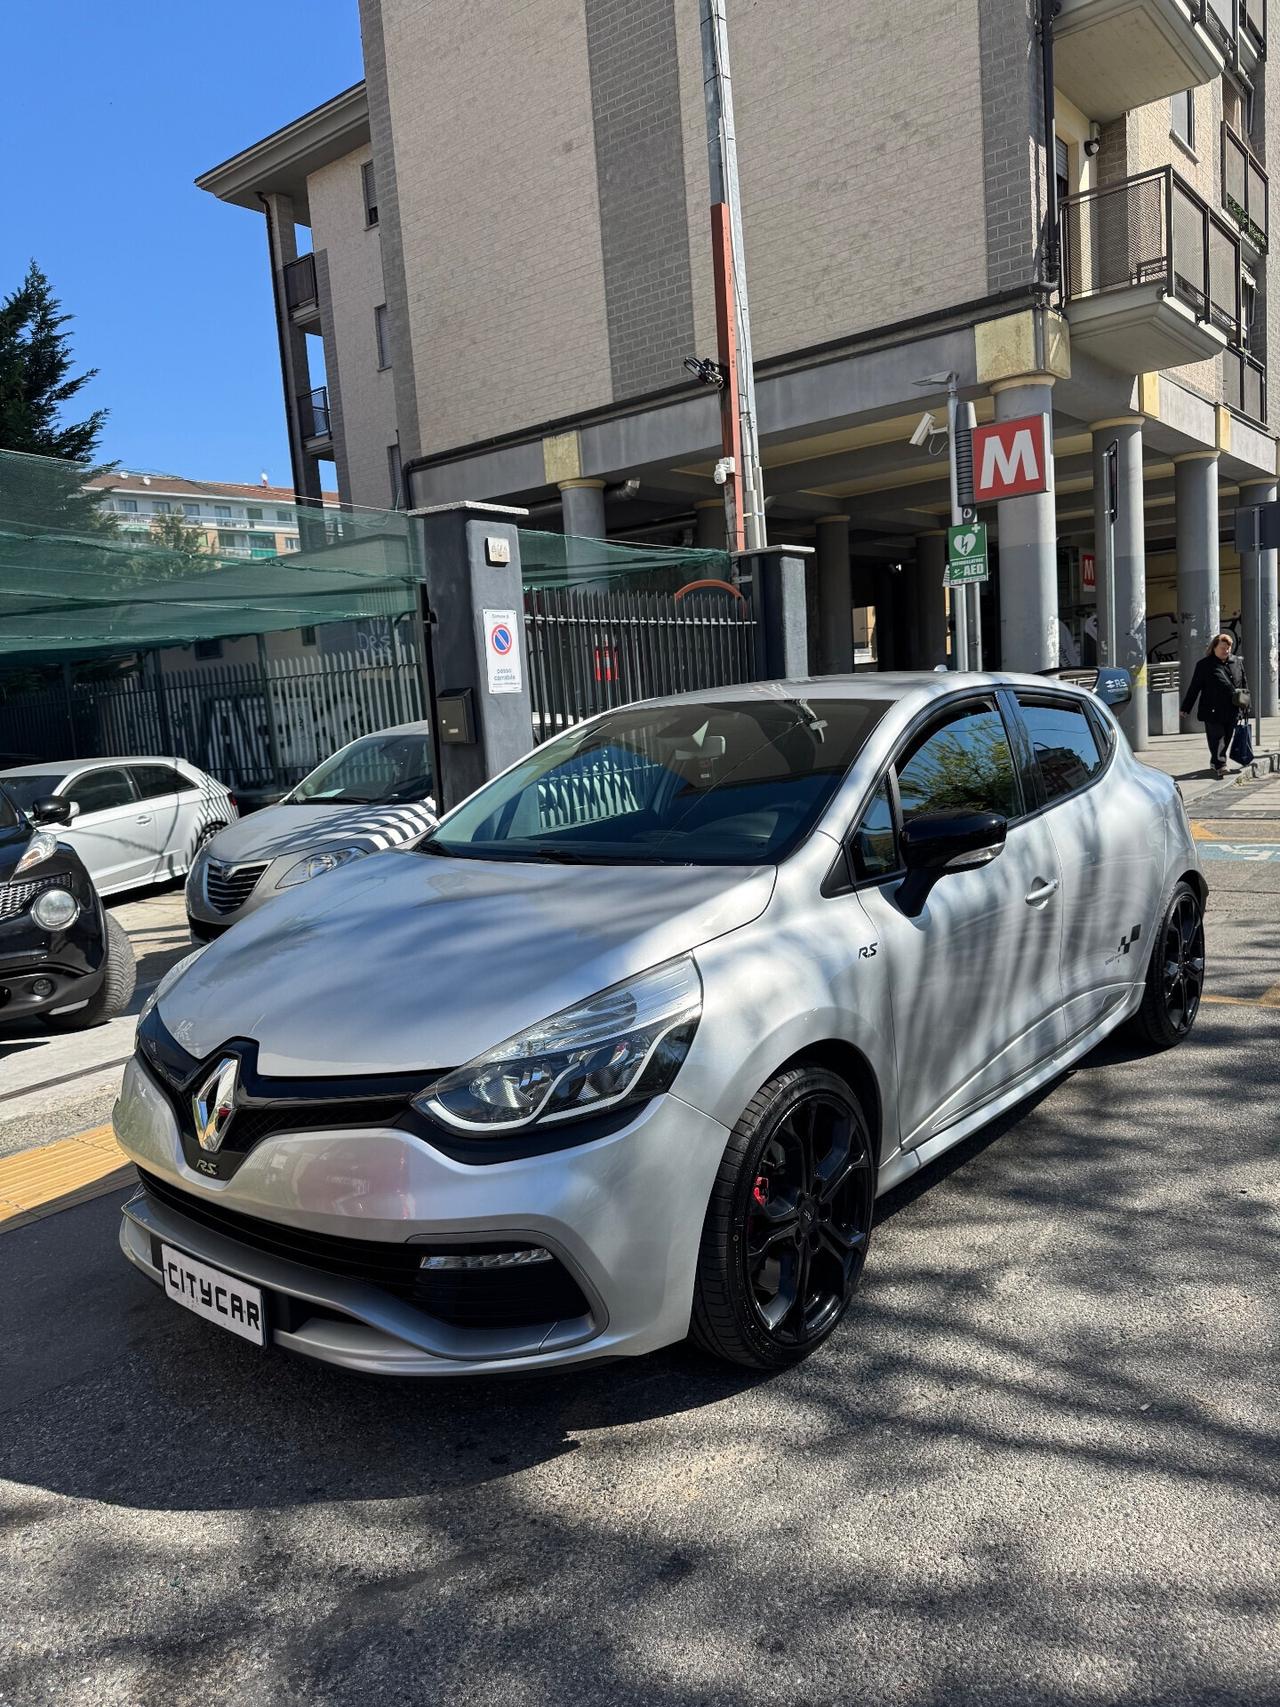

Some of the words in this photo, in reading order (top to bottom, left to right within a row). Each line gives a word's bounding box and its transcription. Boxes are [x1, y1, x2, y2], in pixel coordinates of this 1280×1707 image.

[980, 429, 1040, 490] M
[963, 563, 984, 576] AED
[1084, 559, 1095, 580] M
[167, 1261, 260, 1331] CITYCAR
